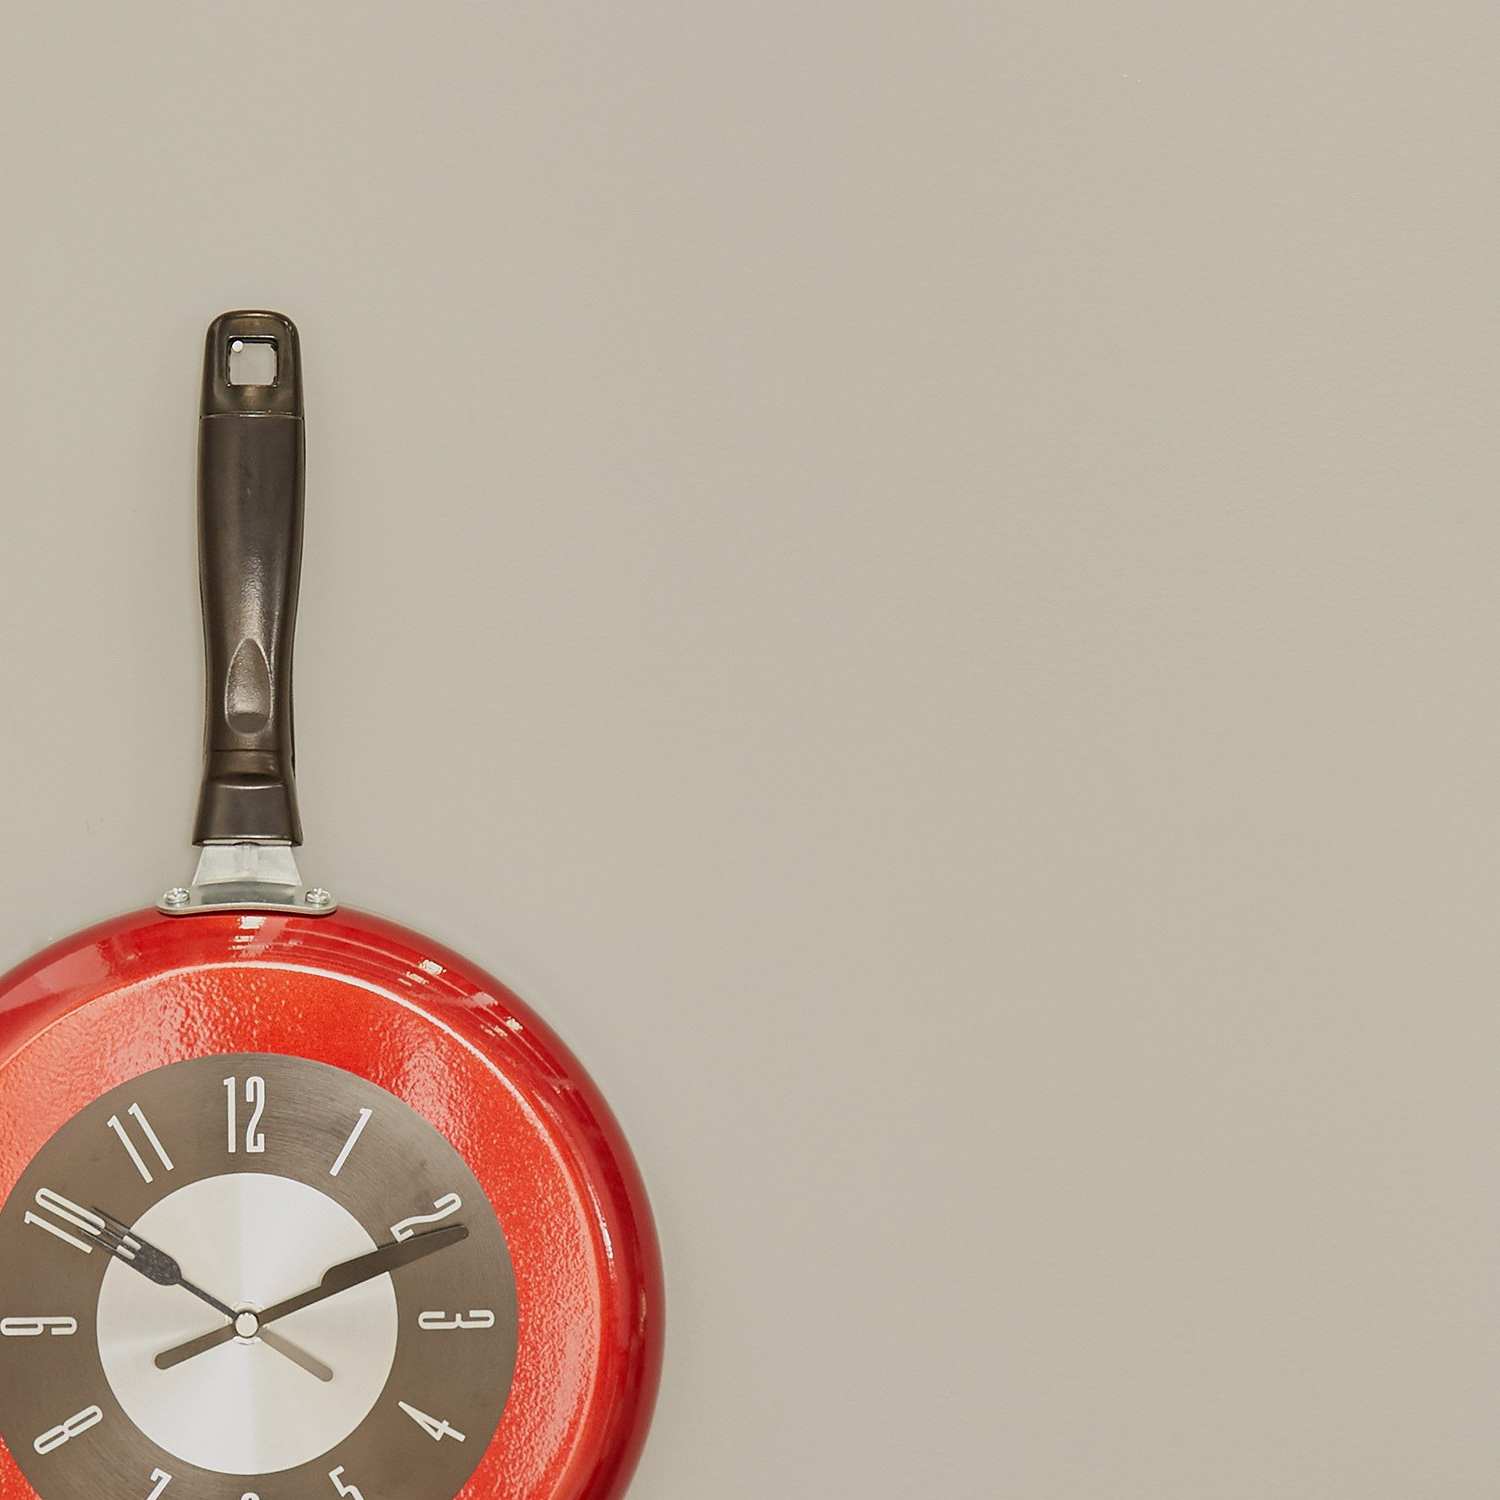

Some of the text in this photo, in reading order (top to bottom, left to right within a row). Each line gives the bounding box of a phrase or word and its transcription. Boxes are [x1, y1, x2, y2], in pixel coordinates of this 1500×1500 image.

[223, 1075, 265, 1153] 12
[106, 1102, 174, 1183] 11
[329, 1107, 373, 1177] 1
[23, 1187, 106, 1254] 10
[390, 1192, 463, 1243] 2
[0, 1316, 78, 1336] 9
[418, 1309, 495, 1330] 3
[33, 1404, 104, 1455] 8
[398, 1401, 466, 1442] 4
